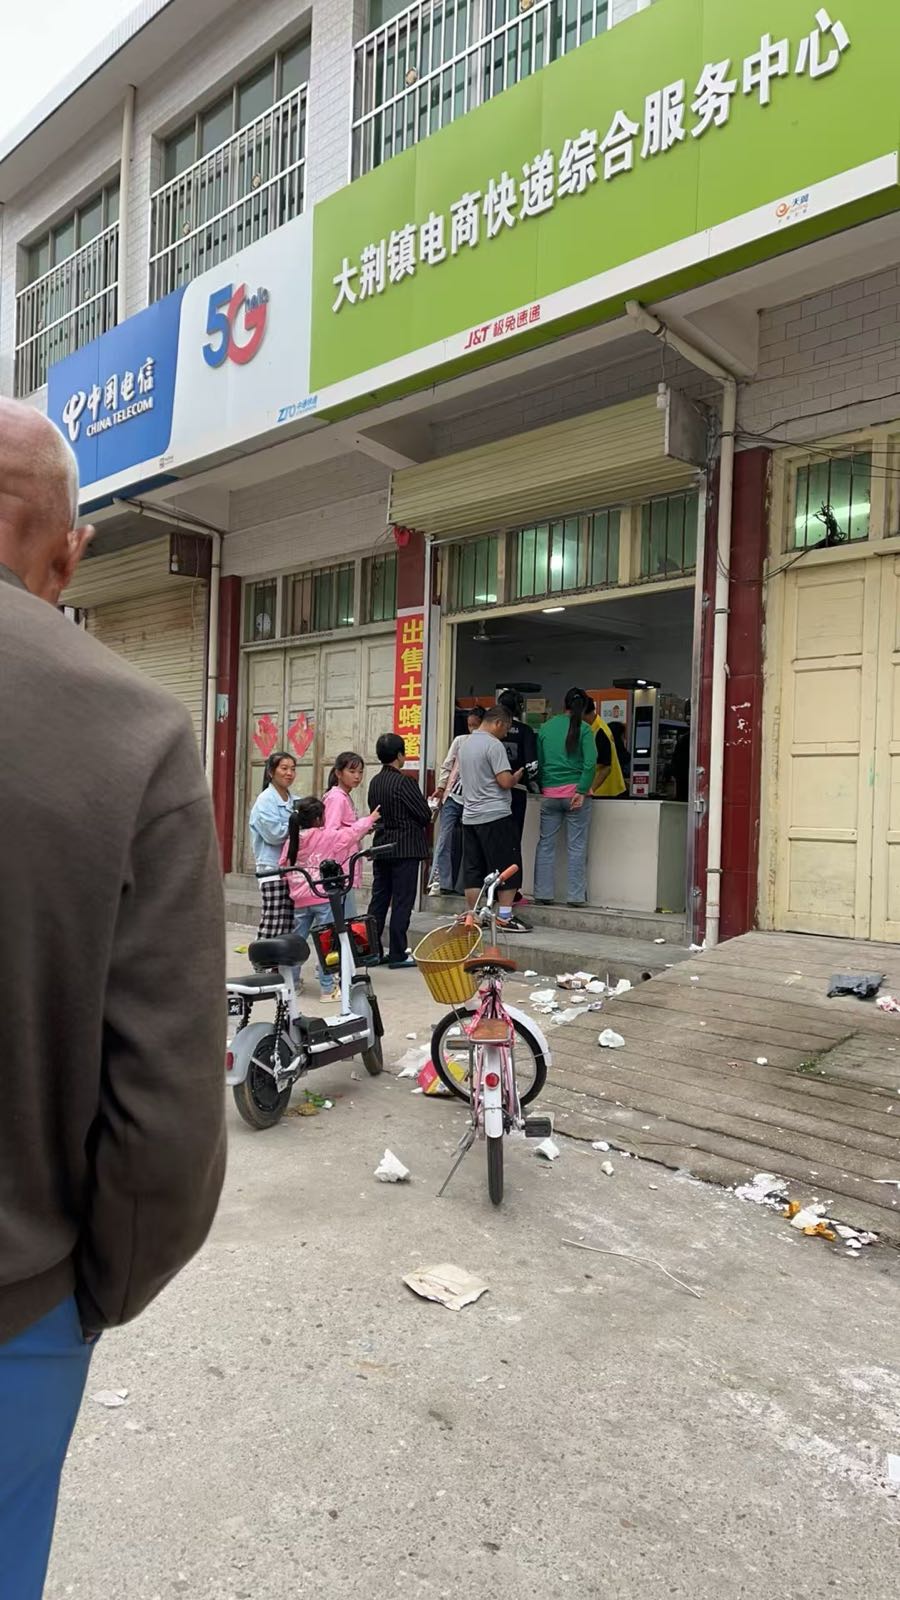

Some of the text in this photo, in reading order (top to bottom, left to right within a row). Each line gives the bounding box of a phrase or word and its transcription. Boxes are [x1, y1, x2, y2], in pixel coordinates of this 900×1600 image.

[332, 8, 851, 312] 大荆镇电商快递综合服务中心
[203, 283, 269, 369] 5G
[464, 304, 541, 349] J&T 极兔速递
[86, 396, 154, 437] CHINA TELECOM
[87, 357, 154, 421] 中国电信
[277, 404, 296, 422] ZTO
[398, 618, 425, 757] 出售土蜂蜜
